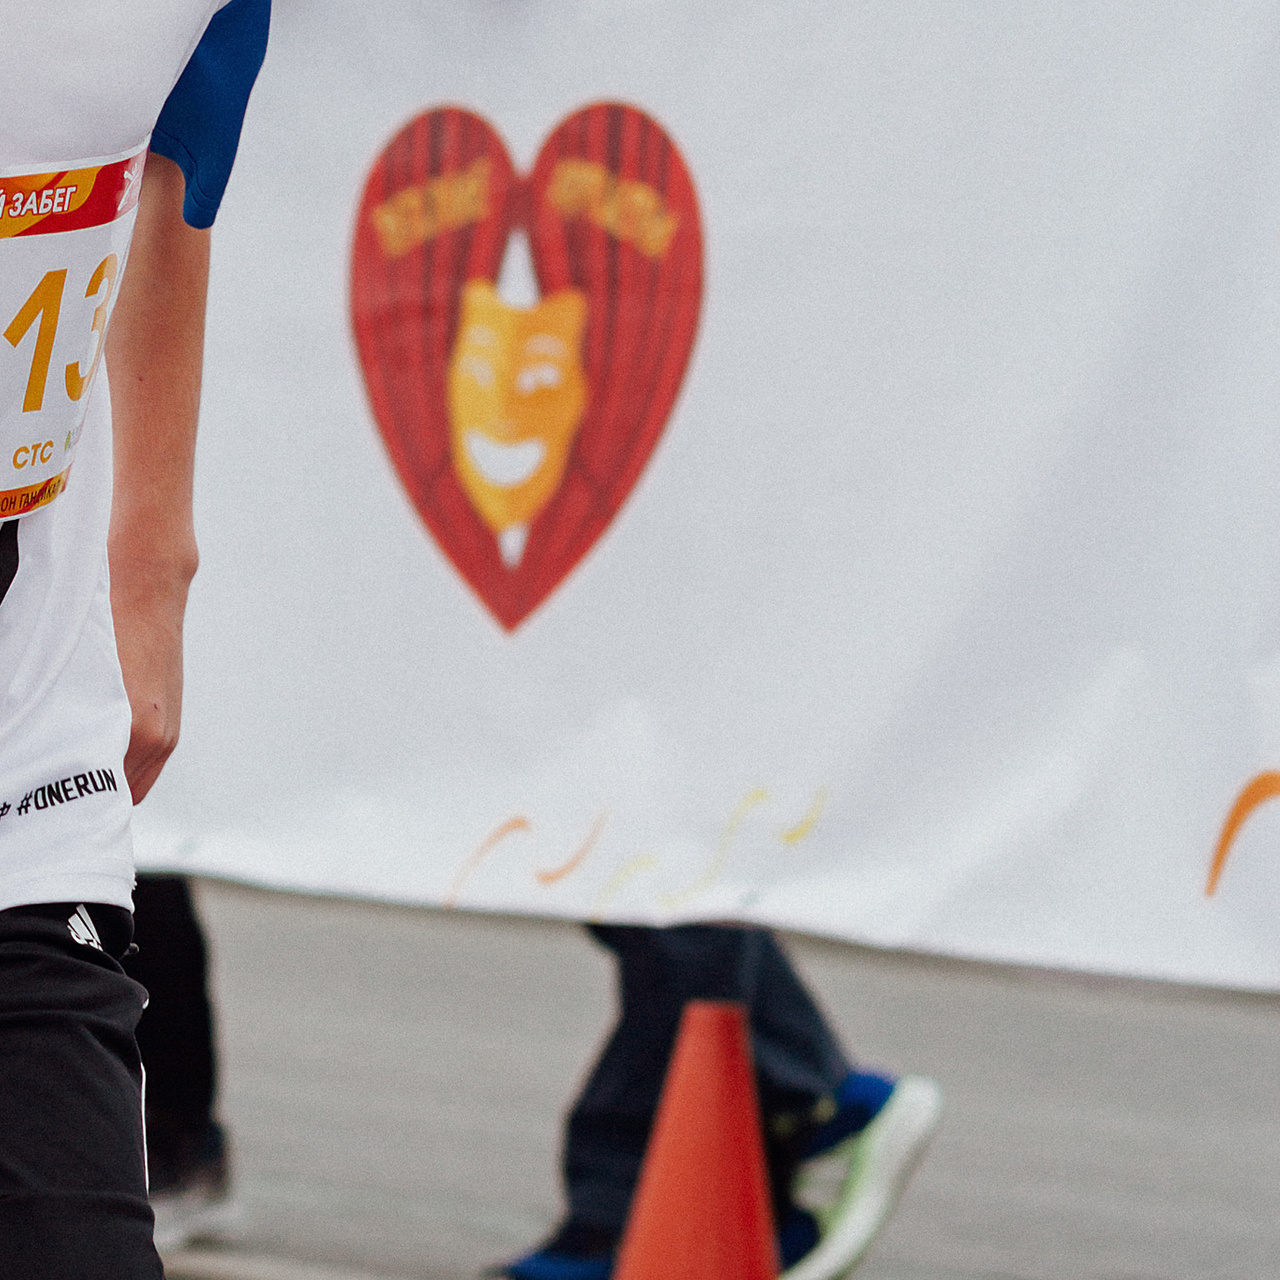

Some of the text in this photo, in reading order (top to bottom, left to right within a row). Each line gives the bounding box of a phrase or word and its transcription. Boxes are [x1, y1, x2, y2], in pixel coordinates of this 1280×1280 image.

[9, 186, 77, 217] ЗАБЕГ
[12, 440, 54, 469] СТС
[17, 768, 118, 816] #ONERUN
